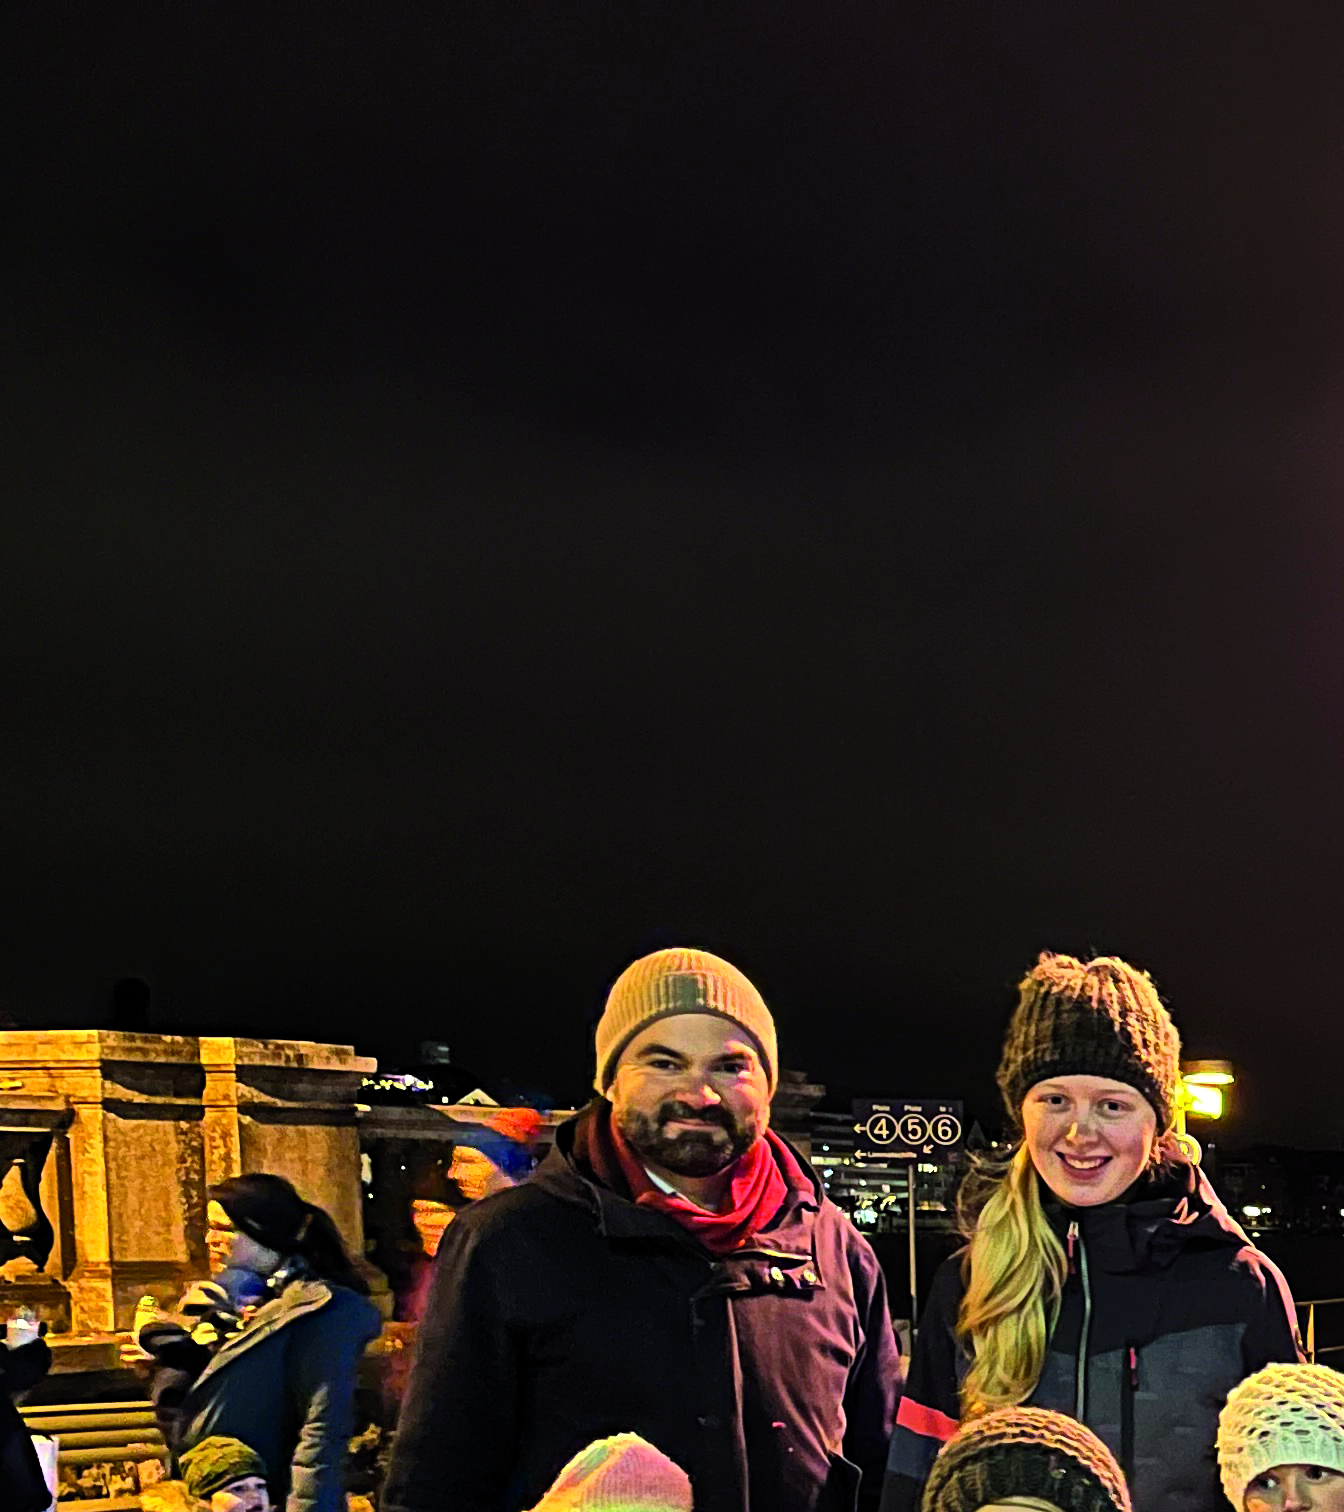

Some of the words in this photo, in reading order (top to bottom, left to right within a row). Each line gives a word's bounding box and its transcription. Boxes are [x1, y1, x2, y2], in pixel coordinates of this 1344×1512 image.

[873, 1117, 890, 1139] 4
[907, 1118, 922, 1140] 5
[937, 1118, 952, 1140] 6
